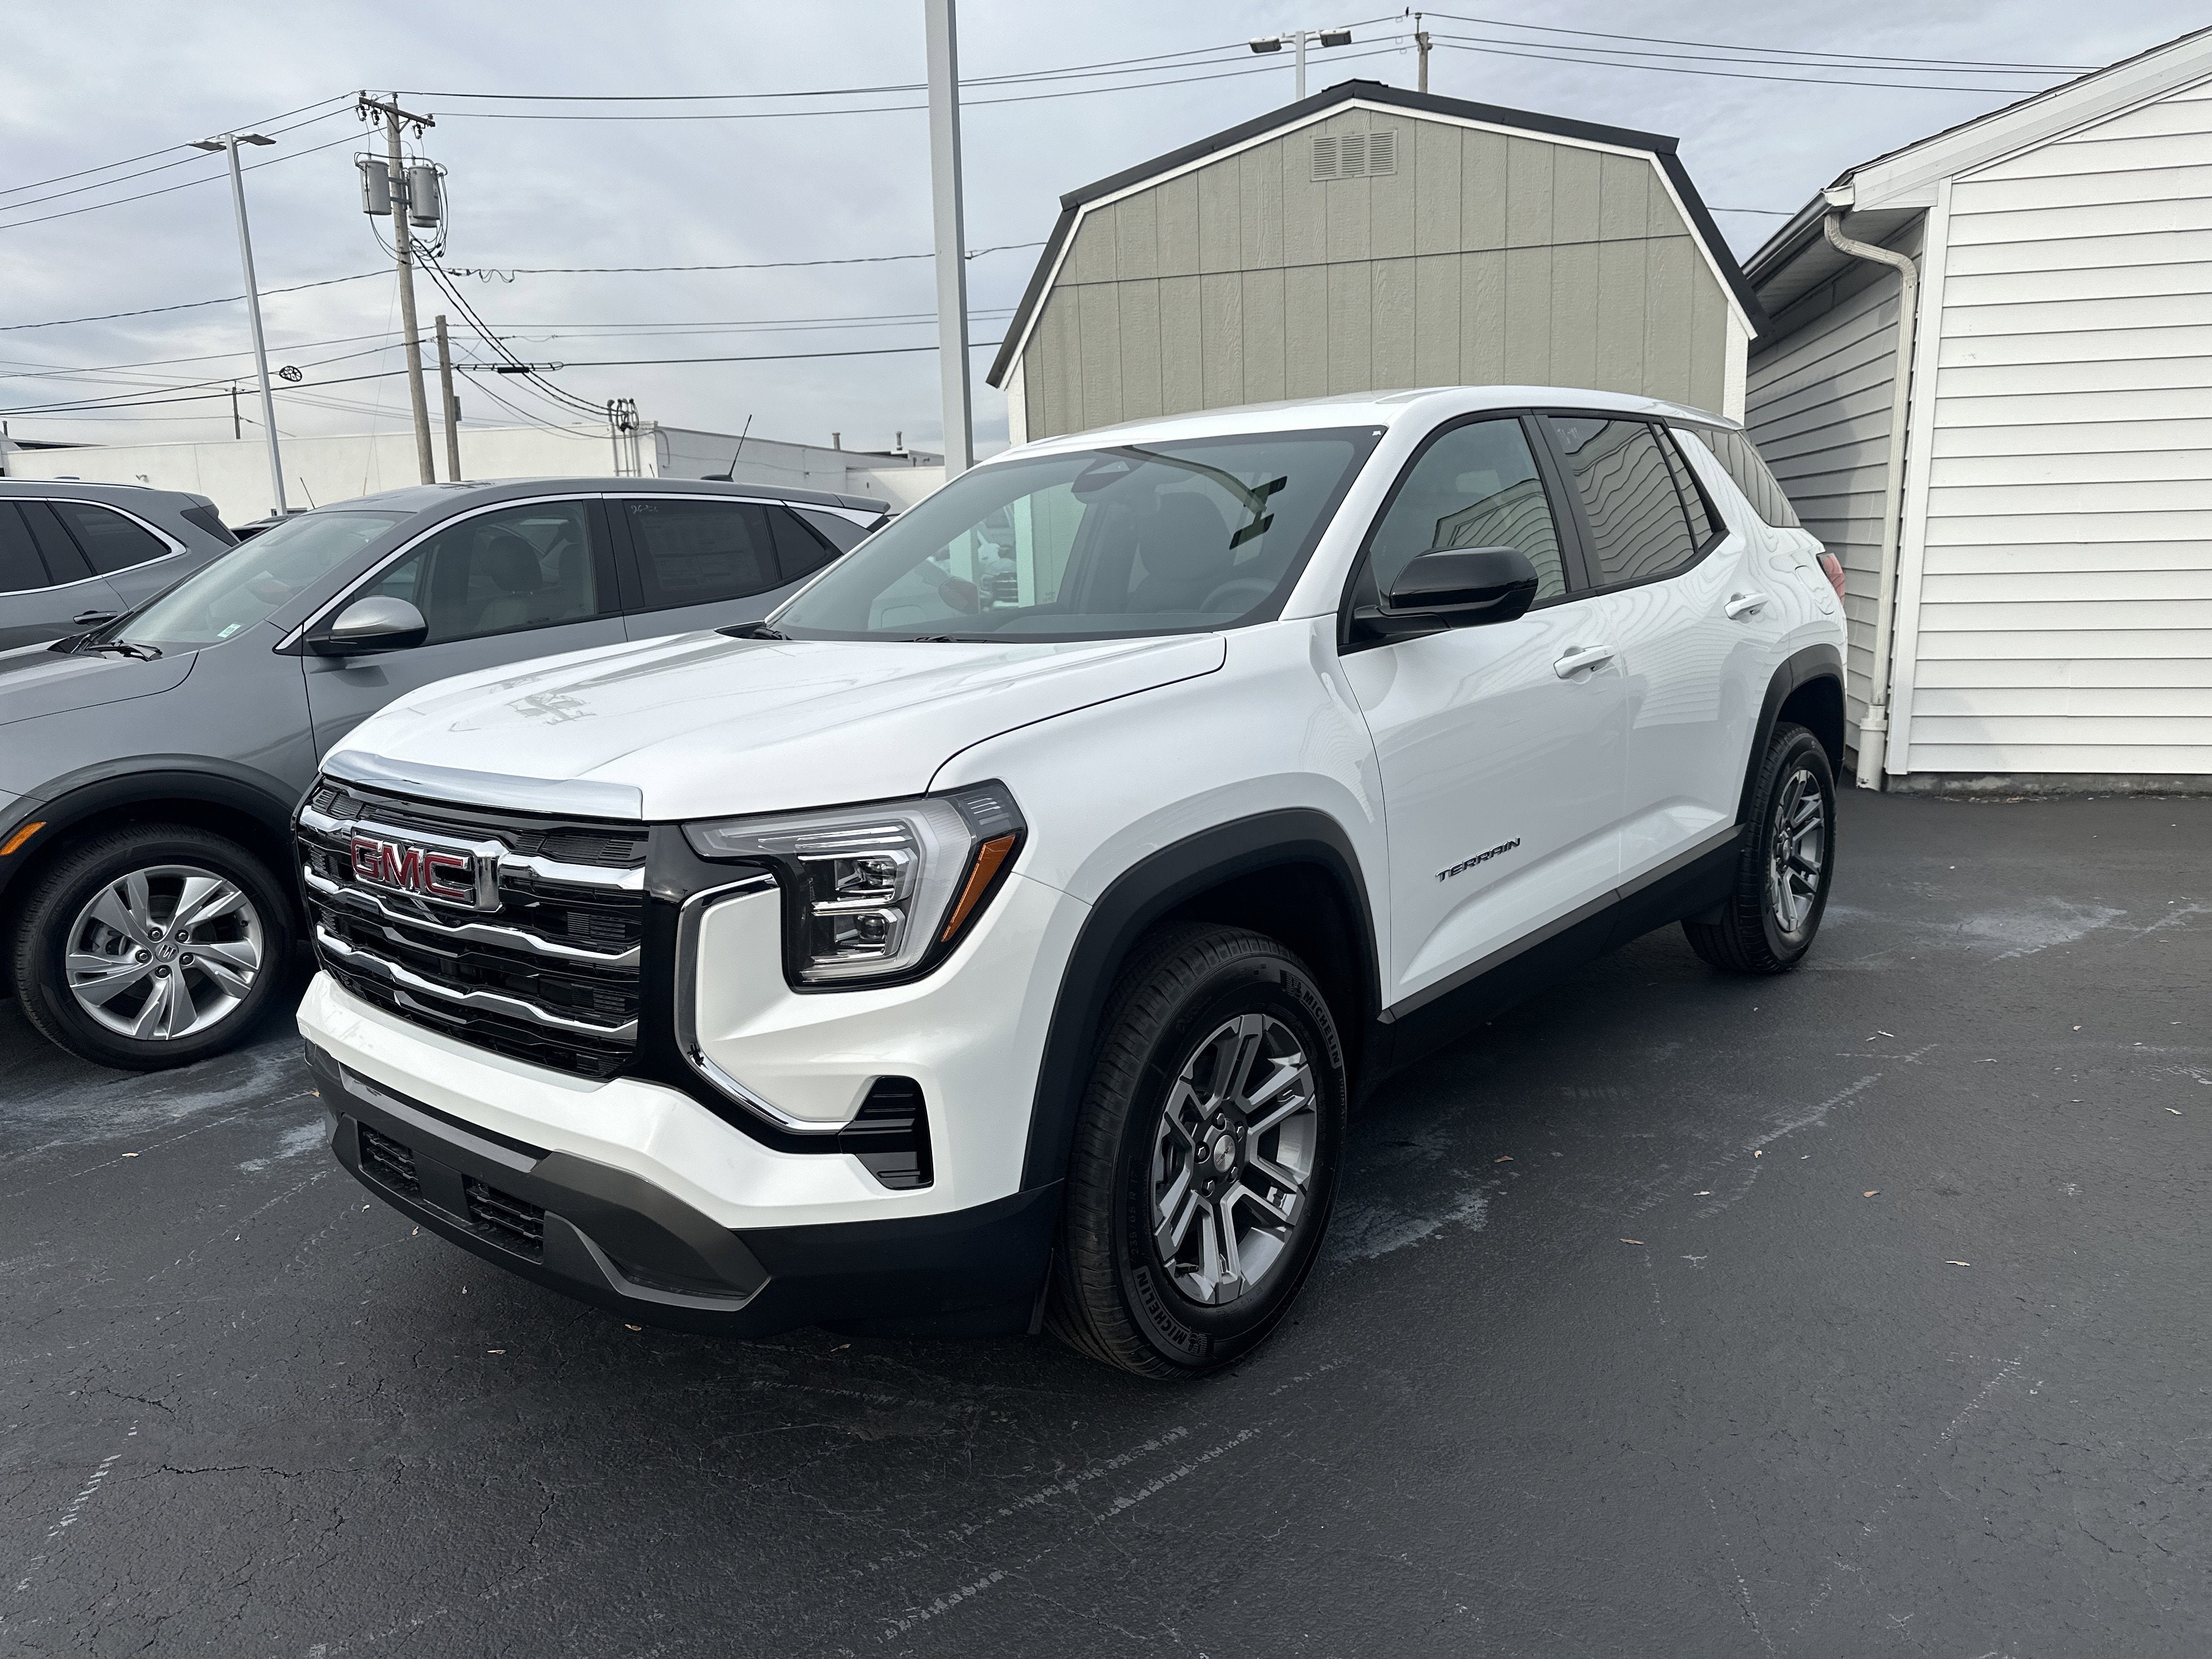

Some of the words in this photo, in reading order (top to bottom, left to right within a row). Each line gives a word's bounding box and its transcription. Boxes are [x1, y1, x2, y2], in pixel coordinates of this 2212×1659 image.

[351, 834, 472, 902] GMC
[1435, 836, 1521, 882] TERRAIN
[1302, 990, 1340, 1064] MICHELIN
[1136, 1272, 1188, 1345] MICHELIN
